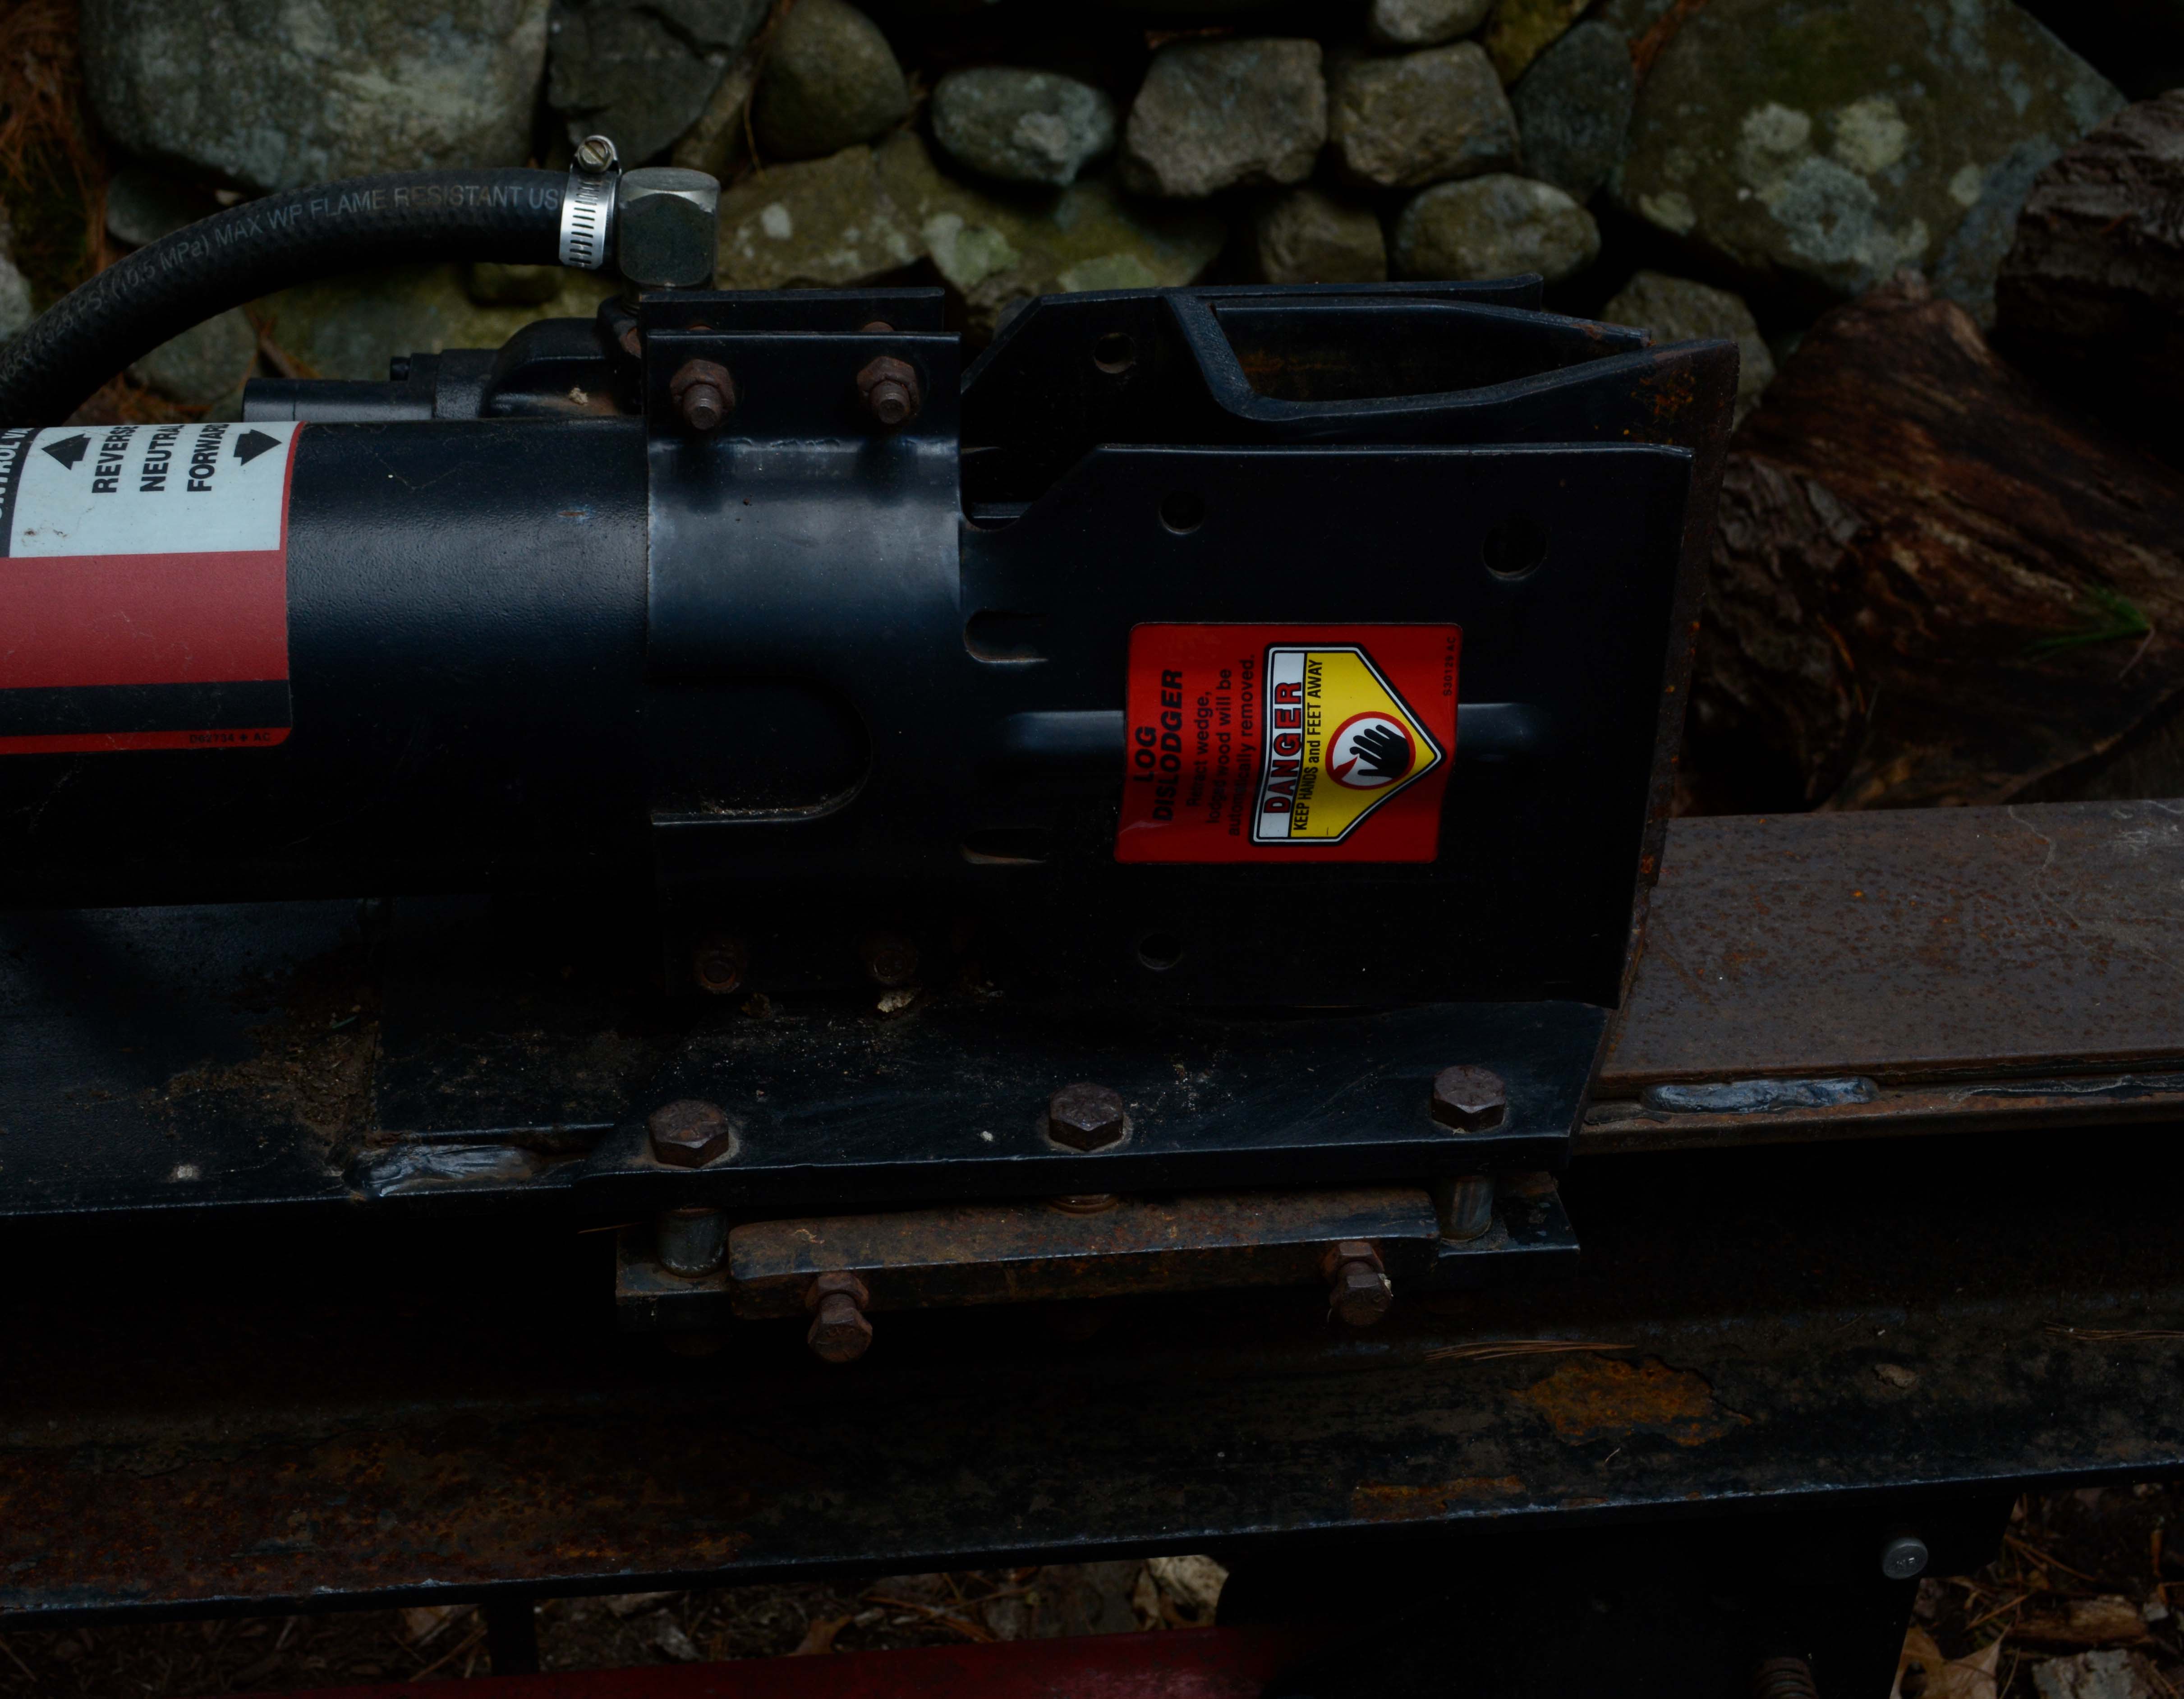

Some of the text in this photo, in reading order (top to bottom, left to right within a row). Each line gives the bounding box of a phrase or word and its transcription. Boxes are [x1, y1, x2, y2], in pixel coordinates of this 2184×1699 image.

[160, 235, 209, 271] MPa)
[214, 215, 263, 247] MAX
[267, 204, 303, 230] WP
[311, 189, 386, 219] FLAME
[394, 184, 523, 207] RESISTANT
[529, 187, 563, 212] US
[140, 425, 184, 492] NEUTRAL
[187, 424, 230, 492] FORWARD
[1216, 669, 1232, 690] be
[1216, 697, 1231, 727] will
[1133, 726, 1156, 783] LOG
[1152, 669, 1183, 821] DISLODGER
[1194, 691, 1213, 756] wedge,
[1216, 733, 1231, 777] wood
[1229, 654, 1255, 836] automatically removed.
[1264, 682, 1302, 813] DANGER
[1293, 659, 1323, 830] KEEP HANDS and FEET AWAY
